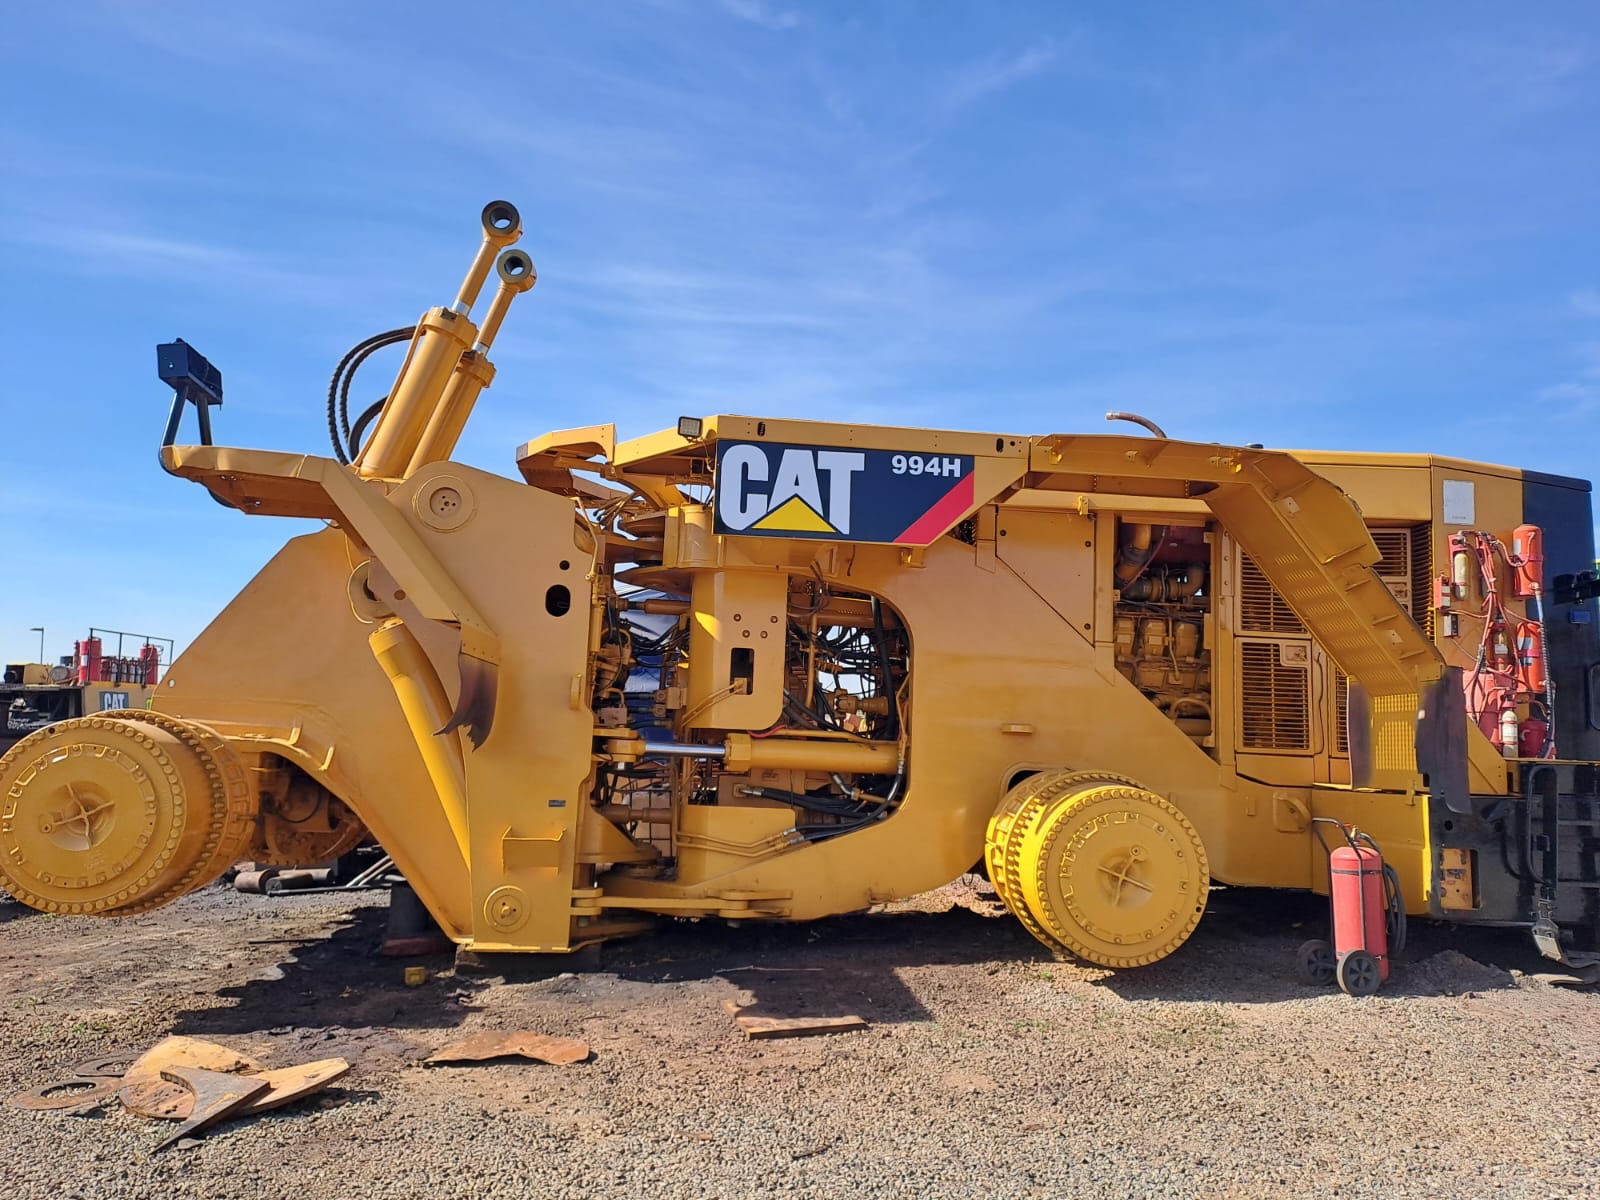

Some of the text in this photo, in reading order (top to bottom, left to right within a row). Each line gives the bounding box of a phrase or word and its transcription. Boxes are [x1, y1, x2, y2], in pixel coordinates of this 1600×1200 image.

[891, 454, 961, 478] 994H
[719, 444, 865, 535] CAT
[104, 693, 125, 711] CAT
